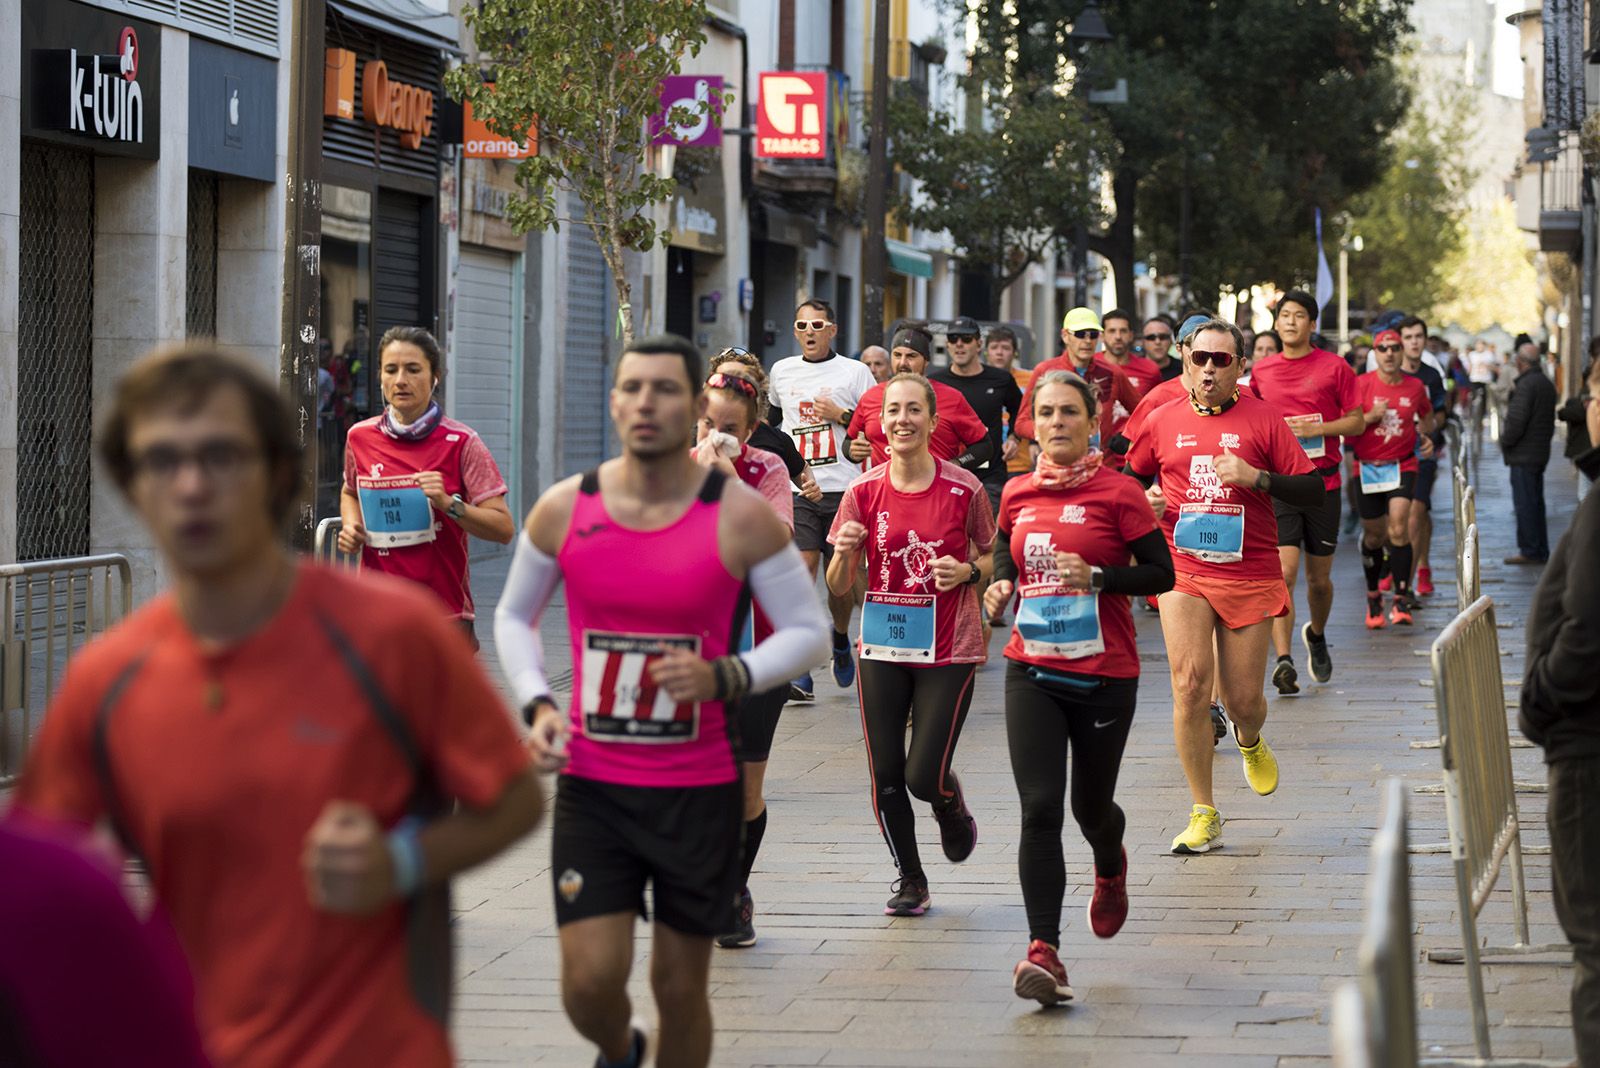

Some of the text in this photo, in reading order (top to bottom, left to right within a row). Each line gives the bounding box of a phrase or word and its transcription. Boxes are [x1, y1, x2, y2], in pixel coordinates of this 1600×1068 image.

[70, 48, 143, 143] k-tuin
[363, 60, 433, 150] Orange
[466, 140, 530, 157] orange
[761, 138, 820, 154] TABACS
[1185, 487, 1233, 500] CUGAT
[380, 497, 401, 508] PILAR
[384, 510, 401, 525] 194
[1199, 531, 1218, 545] 1199
[1025, 559, 1058, 573] SAN
[1026, 572, 1061, 585] CUG
[884, 595, 900, 603] SANT
[900, 597, 922, 605] CUGAT
[887, 613, 907, 624] ANNA
[889, 625, 905, 640] 196
